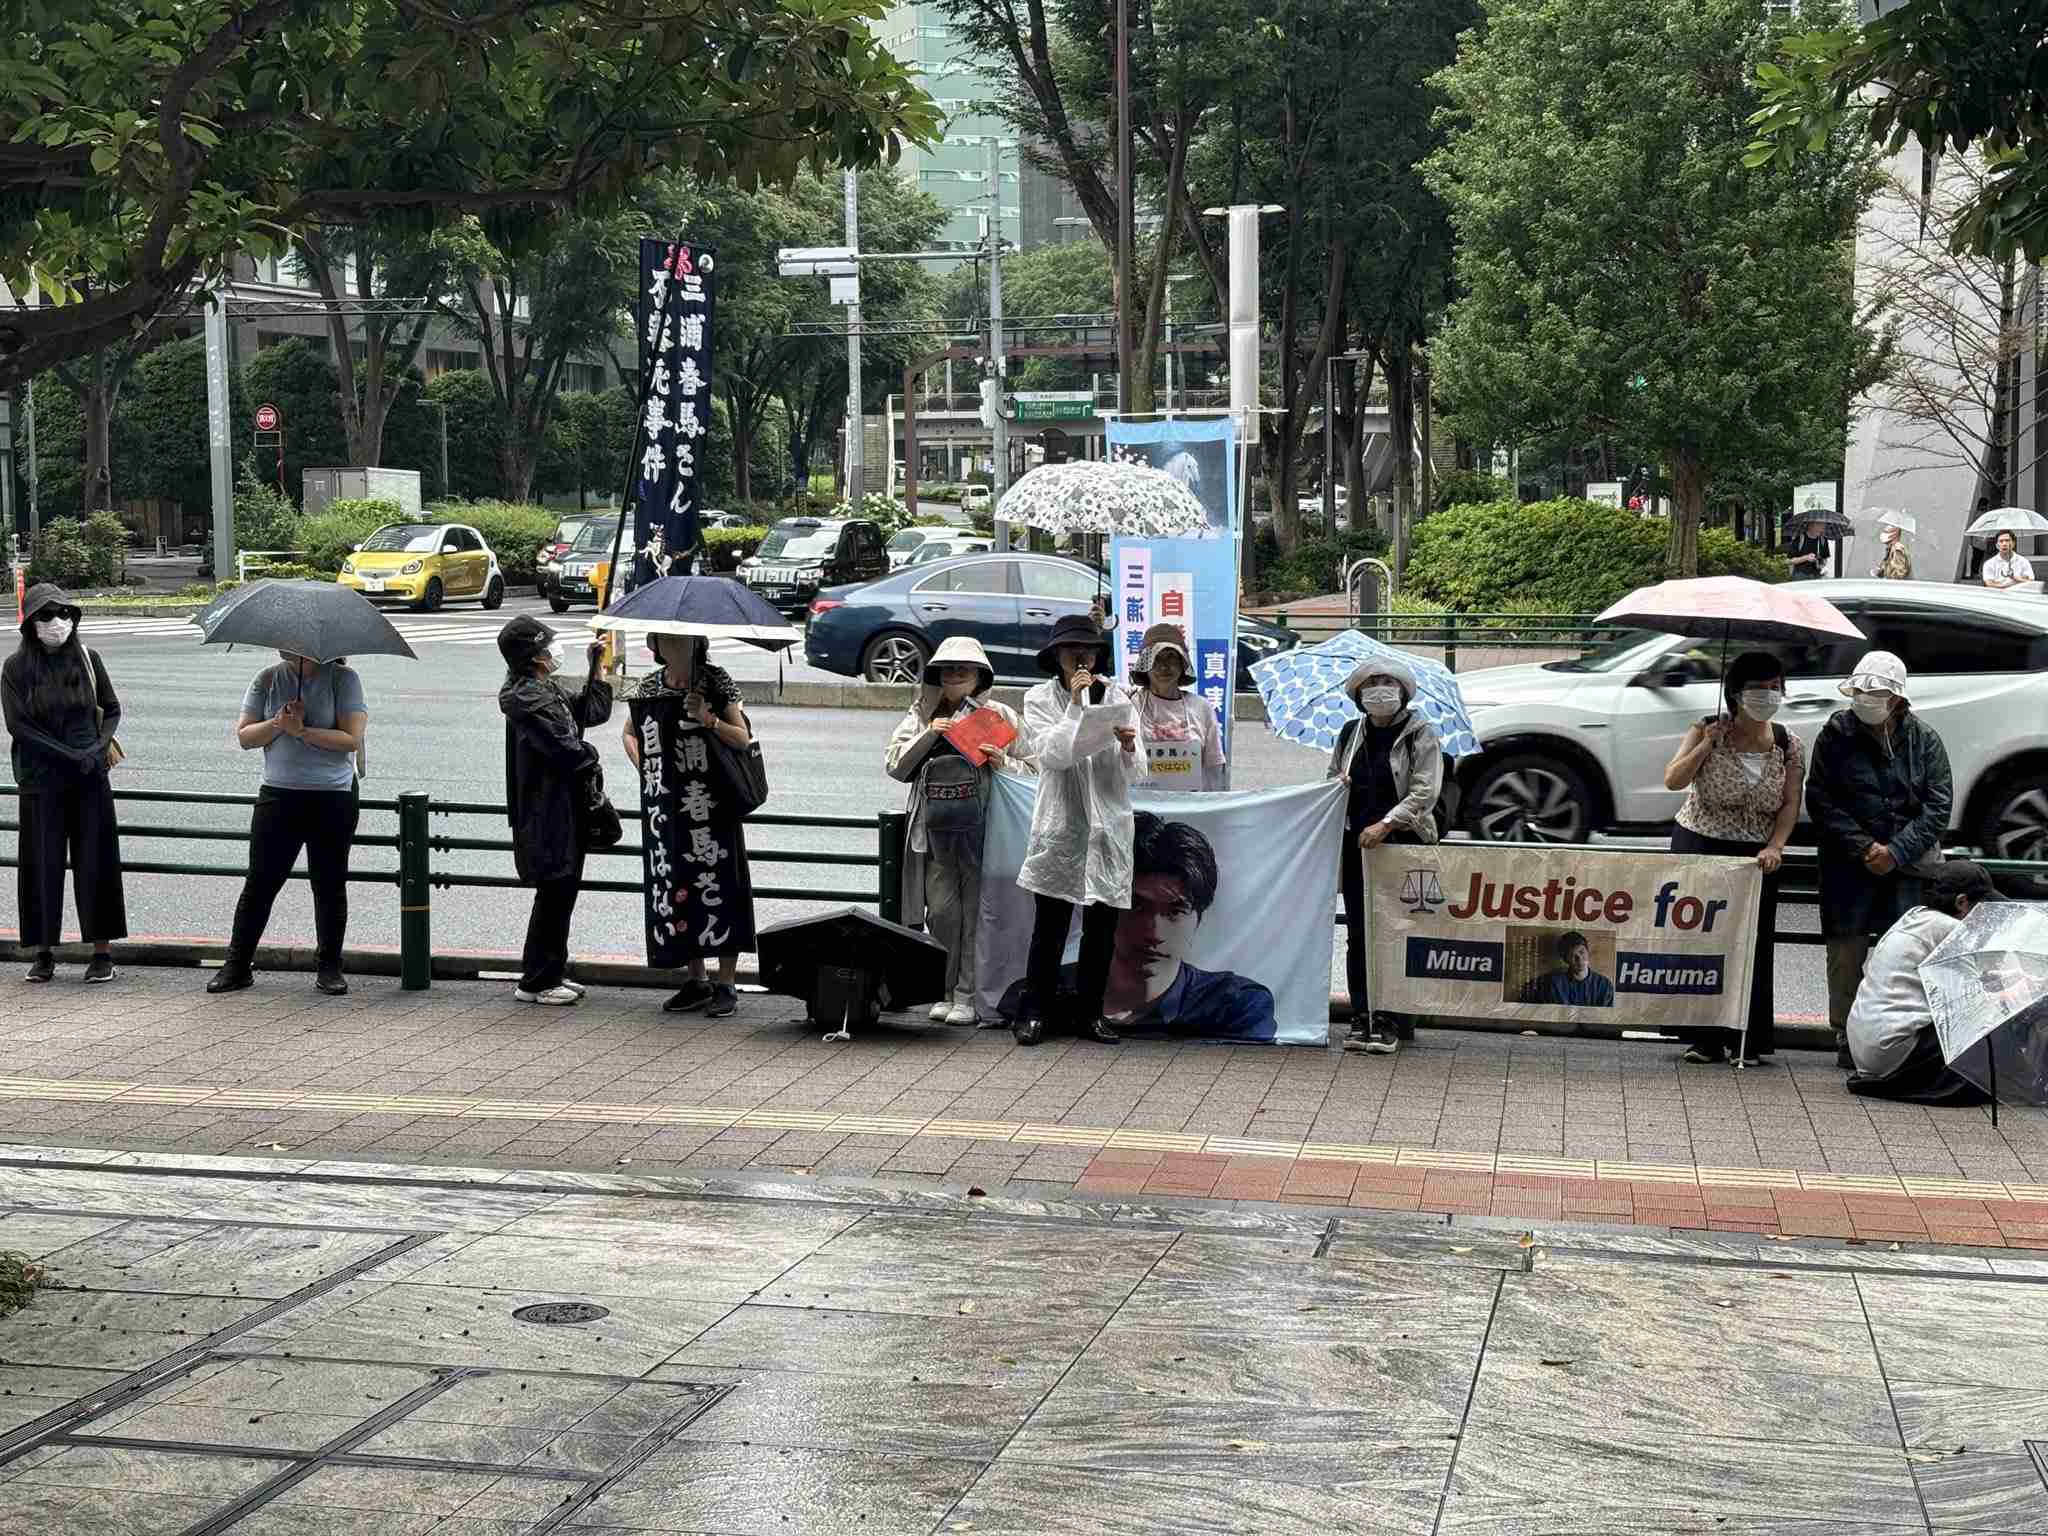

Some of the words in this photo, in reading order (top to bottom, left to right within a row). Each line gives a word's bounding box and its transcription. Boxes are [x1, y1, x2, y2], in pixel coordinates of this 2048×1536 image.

[670, 273, 706, 514] 三浦春馬さん
[640, 714, 676, 946] 自殺ではない
[1448, 872, 1633, 923] Justice
[1654, 881, 1727, 933] for
[1426, 949, 1493, 973] Miura
[1619, 962, 1718, 987] Haruma
